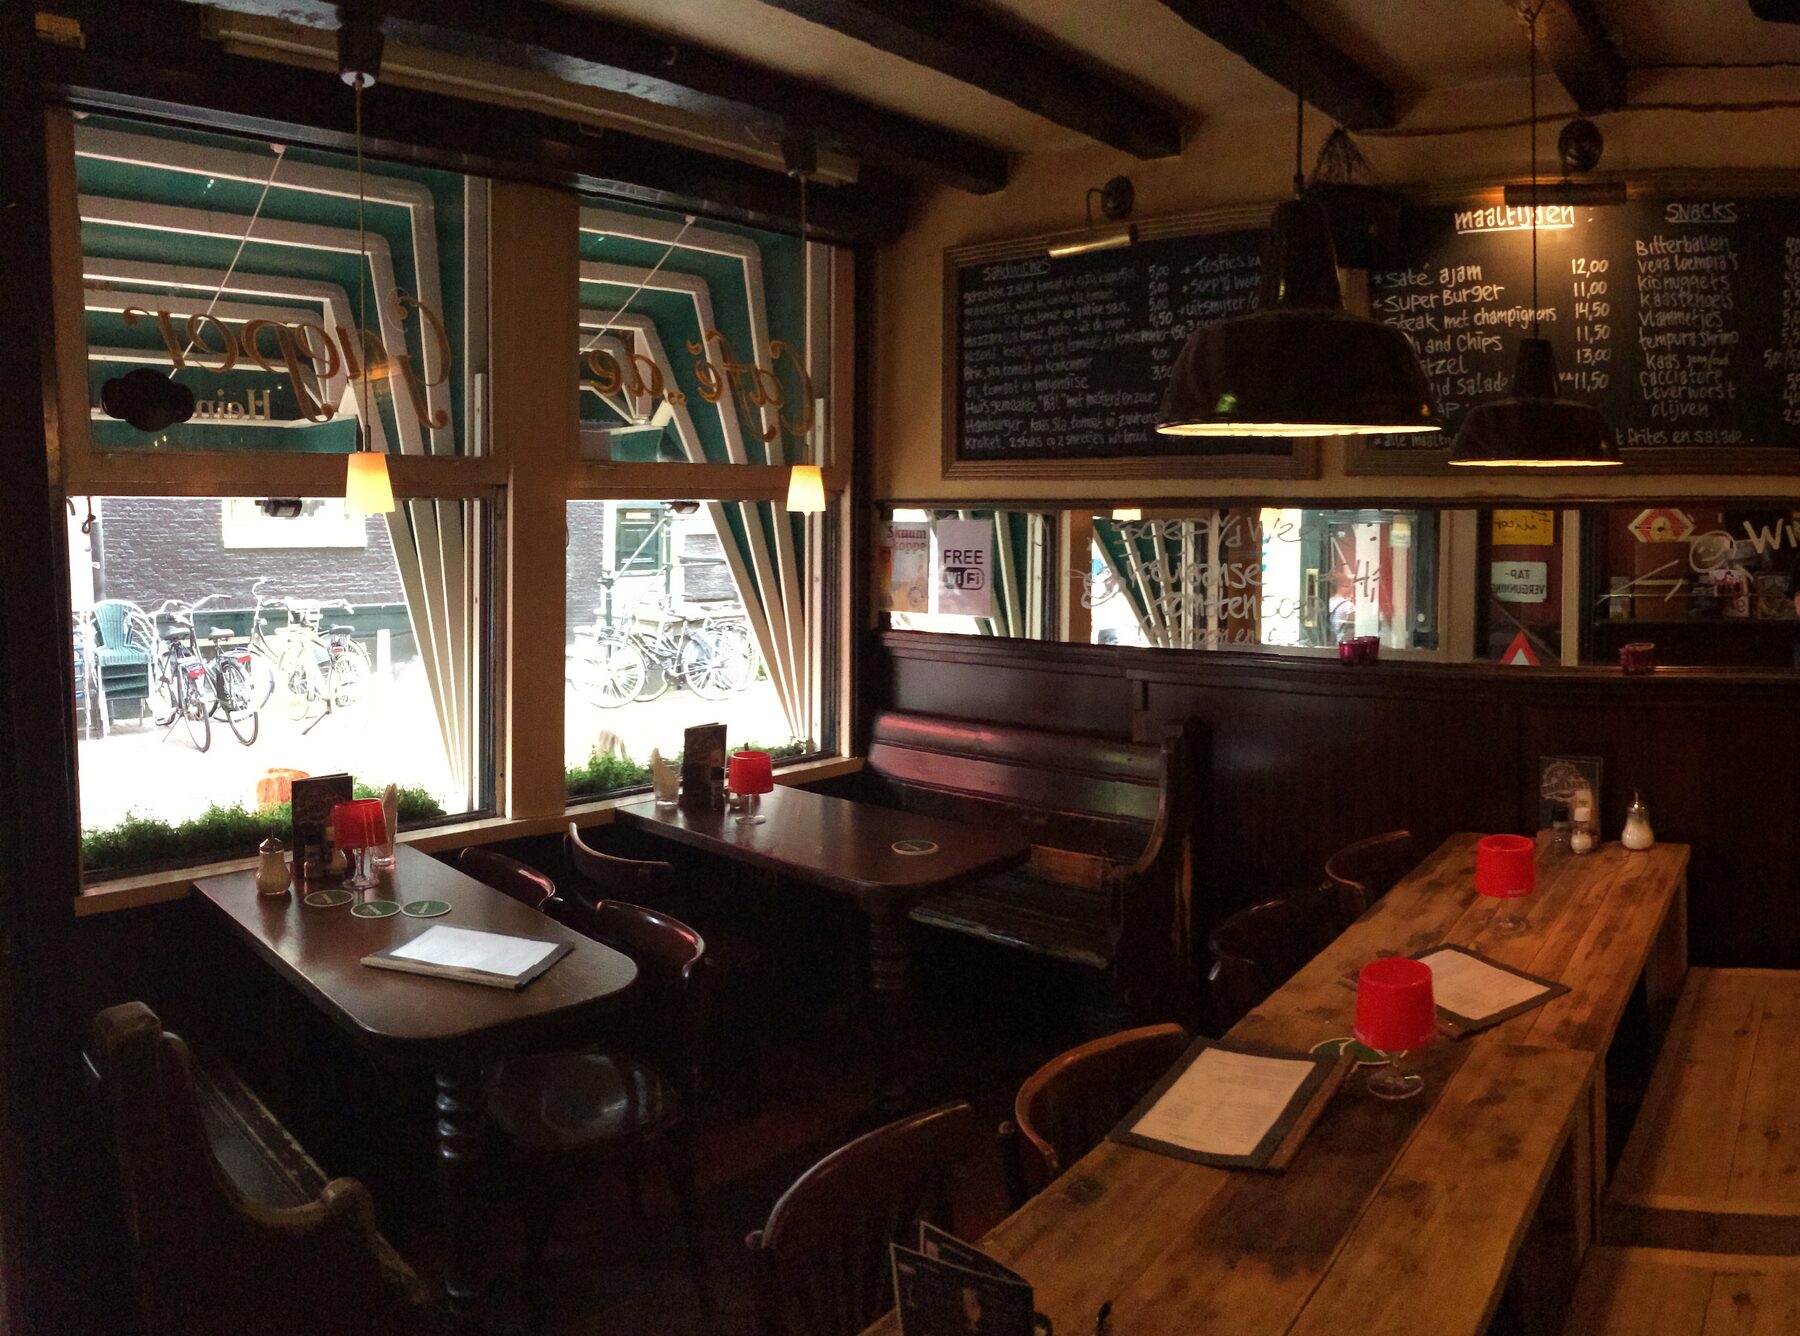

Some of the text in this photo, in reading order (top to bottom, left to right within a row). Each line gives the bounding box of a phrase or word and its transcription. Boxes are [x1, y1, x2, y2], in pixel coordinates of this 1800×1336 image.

[1636, 235, 1729, 256] Bitterballen
[1439, 265, 1482, 288] ajam
[1571, 258, 1608, 278] 12,00
[1442, 284, 1504, 306] Burger
[1573, 282, 1608, 299] 11,00
[1444, 310, 1469, 329] met
[1473, 306, 1557, 330] champignons
[1575, 303, 1610, 321] 14,50
[1425, 334, 1451, 354] and
[1456, 331, 1503, 354] Chips
[1577, 325, 1610, 345] 11,50
[1577, 348, 1611, 366] 13,00
[1575, 371, 1609, 392] 11,50
[1672, 430, 1690, 443] en
[943, 549, 984, 565] FREE
